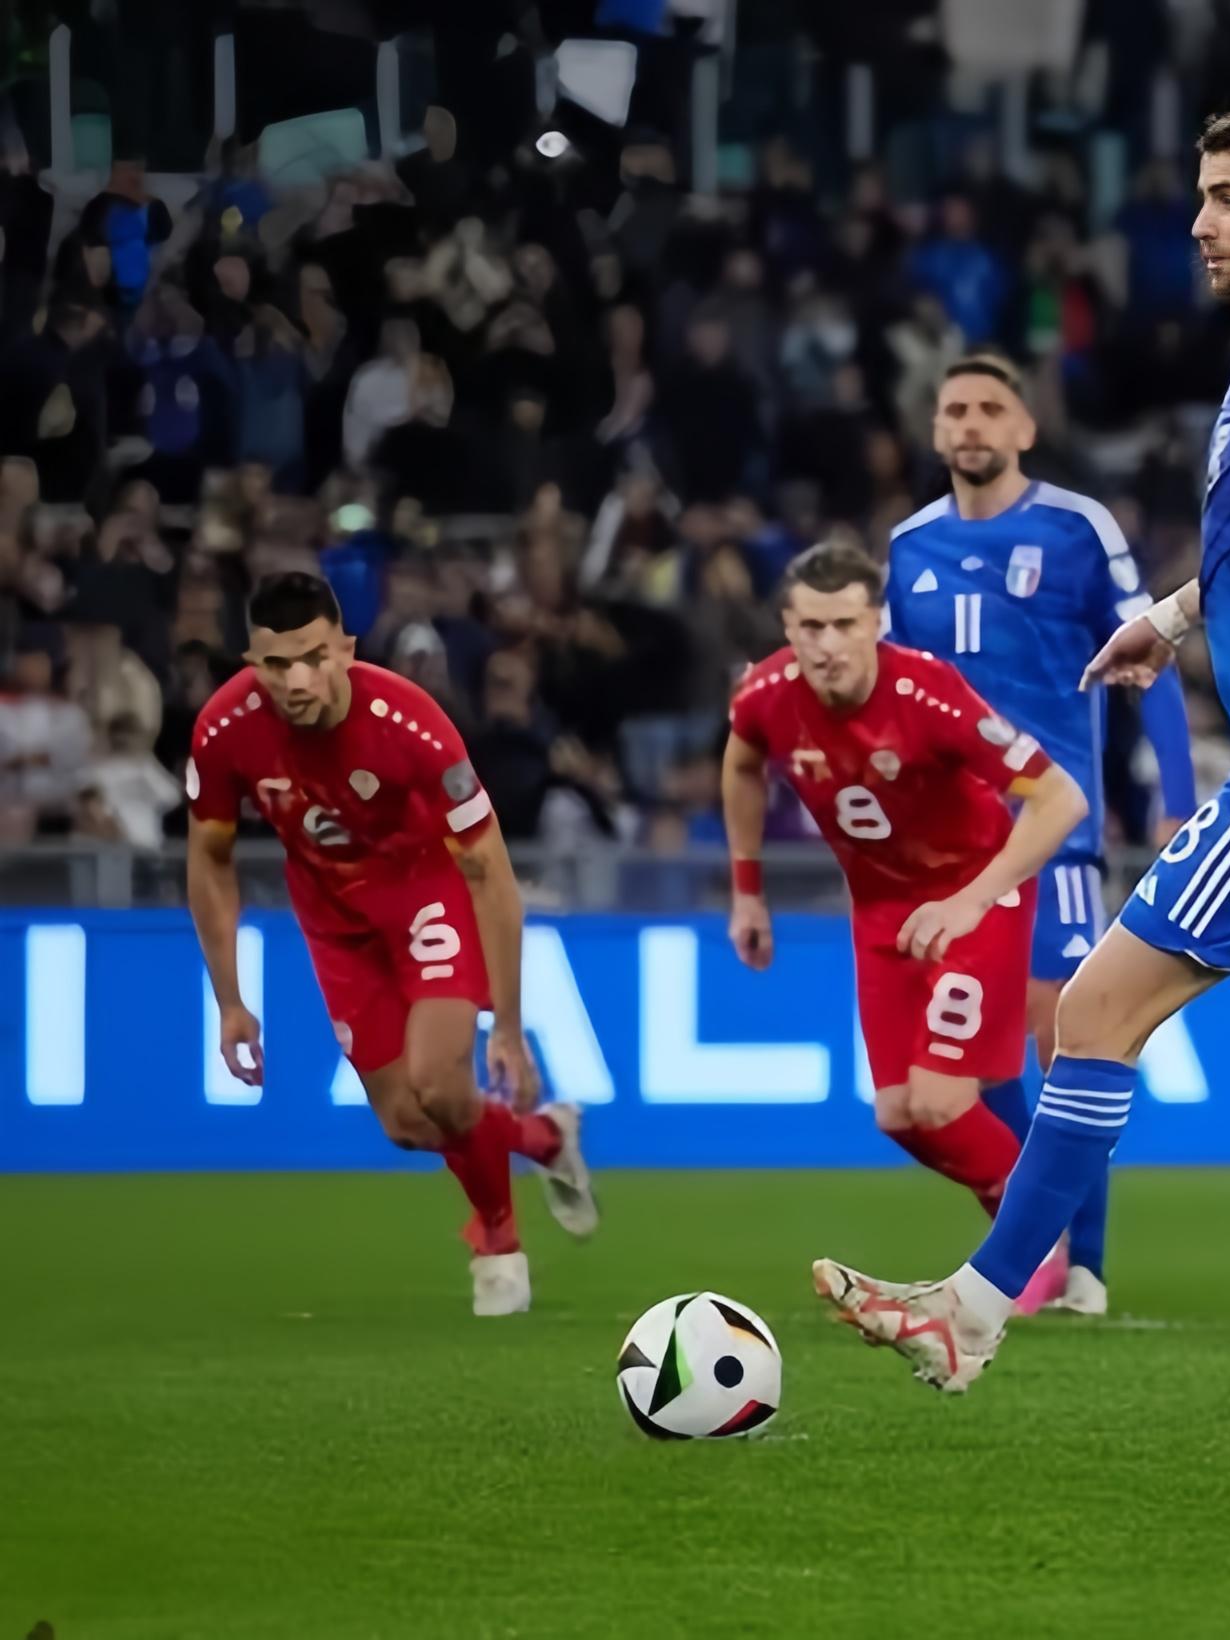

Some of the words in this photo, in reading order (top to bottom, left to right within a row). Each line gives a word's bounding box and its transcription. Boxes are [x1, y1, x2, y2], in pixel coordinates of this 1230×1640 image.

[955, 593, 982, 654] 11
[835, 785, 892, 840] 8
[408, 901, 461, 962] 6
[926, 972, 984, 1041] 8
